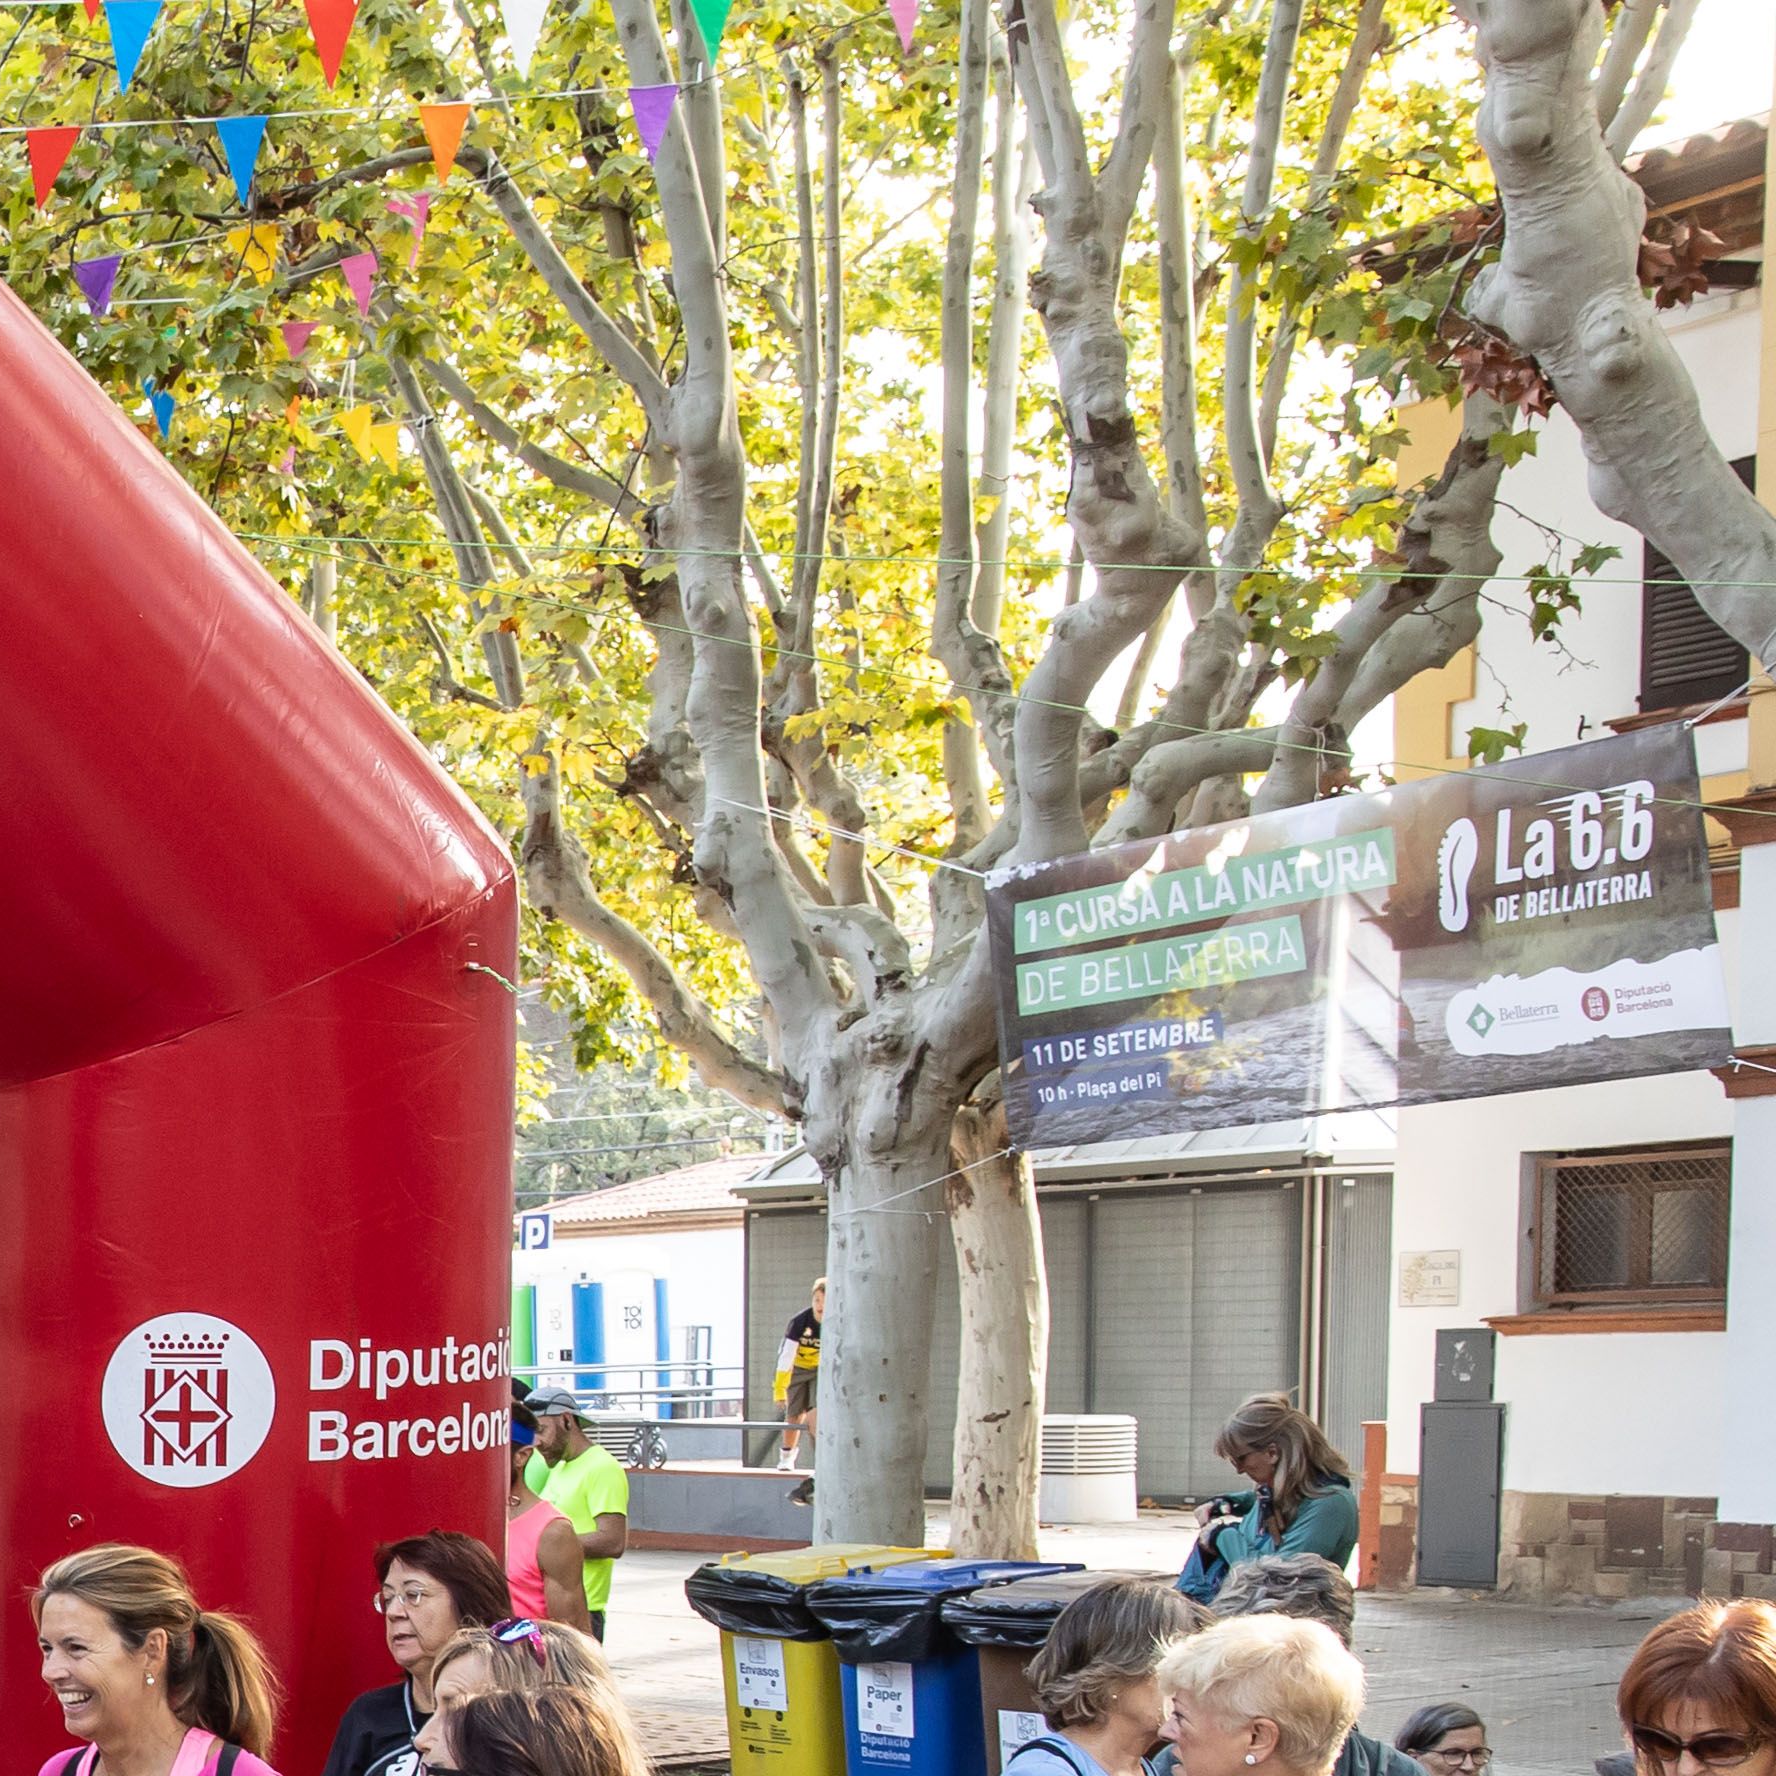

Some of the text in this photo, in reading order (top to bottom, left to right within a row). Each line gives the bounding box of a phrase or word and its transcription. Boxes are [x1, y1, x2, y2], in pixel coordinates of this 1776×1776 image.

[1495, 779, 1656, 885] La 6.6
[1055, 885, 1162, 938] CURSA
[1167, 880, 1199, 917] A
[1196, 870, 1237, 913] LA
[1242, 840, 1389, 904] NATURA
[1495, 870, 1653, 924] DE BELLATERRA
[1024, 925, 1299, 1007] DE BELLATERRA
[1613, 981, 1672, 1002] Diputació
[1615, 995, 1674, 1015] Barcelona
[1498, 1002, 1560, 1023] Bellaterra
[1032, 1017, 1216, 1067] 11 DE SETEMBRE
[1037, 1072, 1162, 1103] 10 h Plaça del Pi
[524, 1217, 545, 1250] P
[308, 1326, 512, 1401] Diputació
[308, 1399, 512, 1463] Barcelona
[739, 1661, 780, 1678] Envasos
[866, 1685, 902, 1703] Paper
[860, 1732, 911, 1750] Diputació
[861, 1746, 912, 1762] Barcelona
